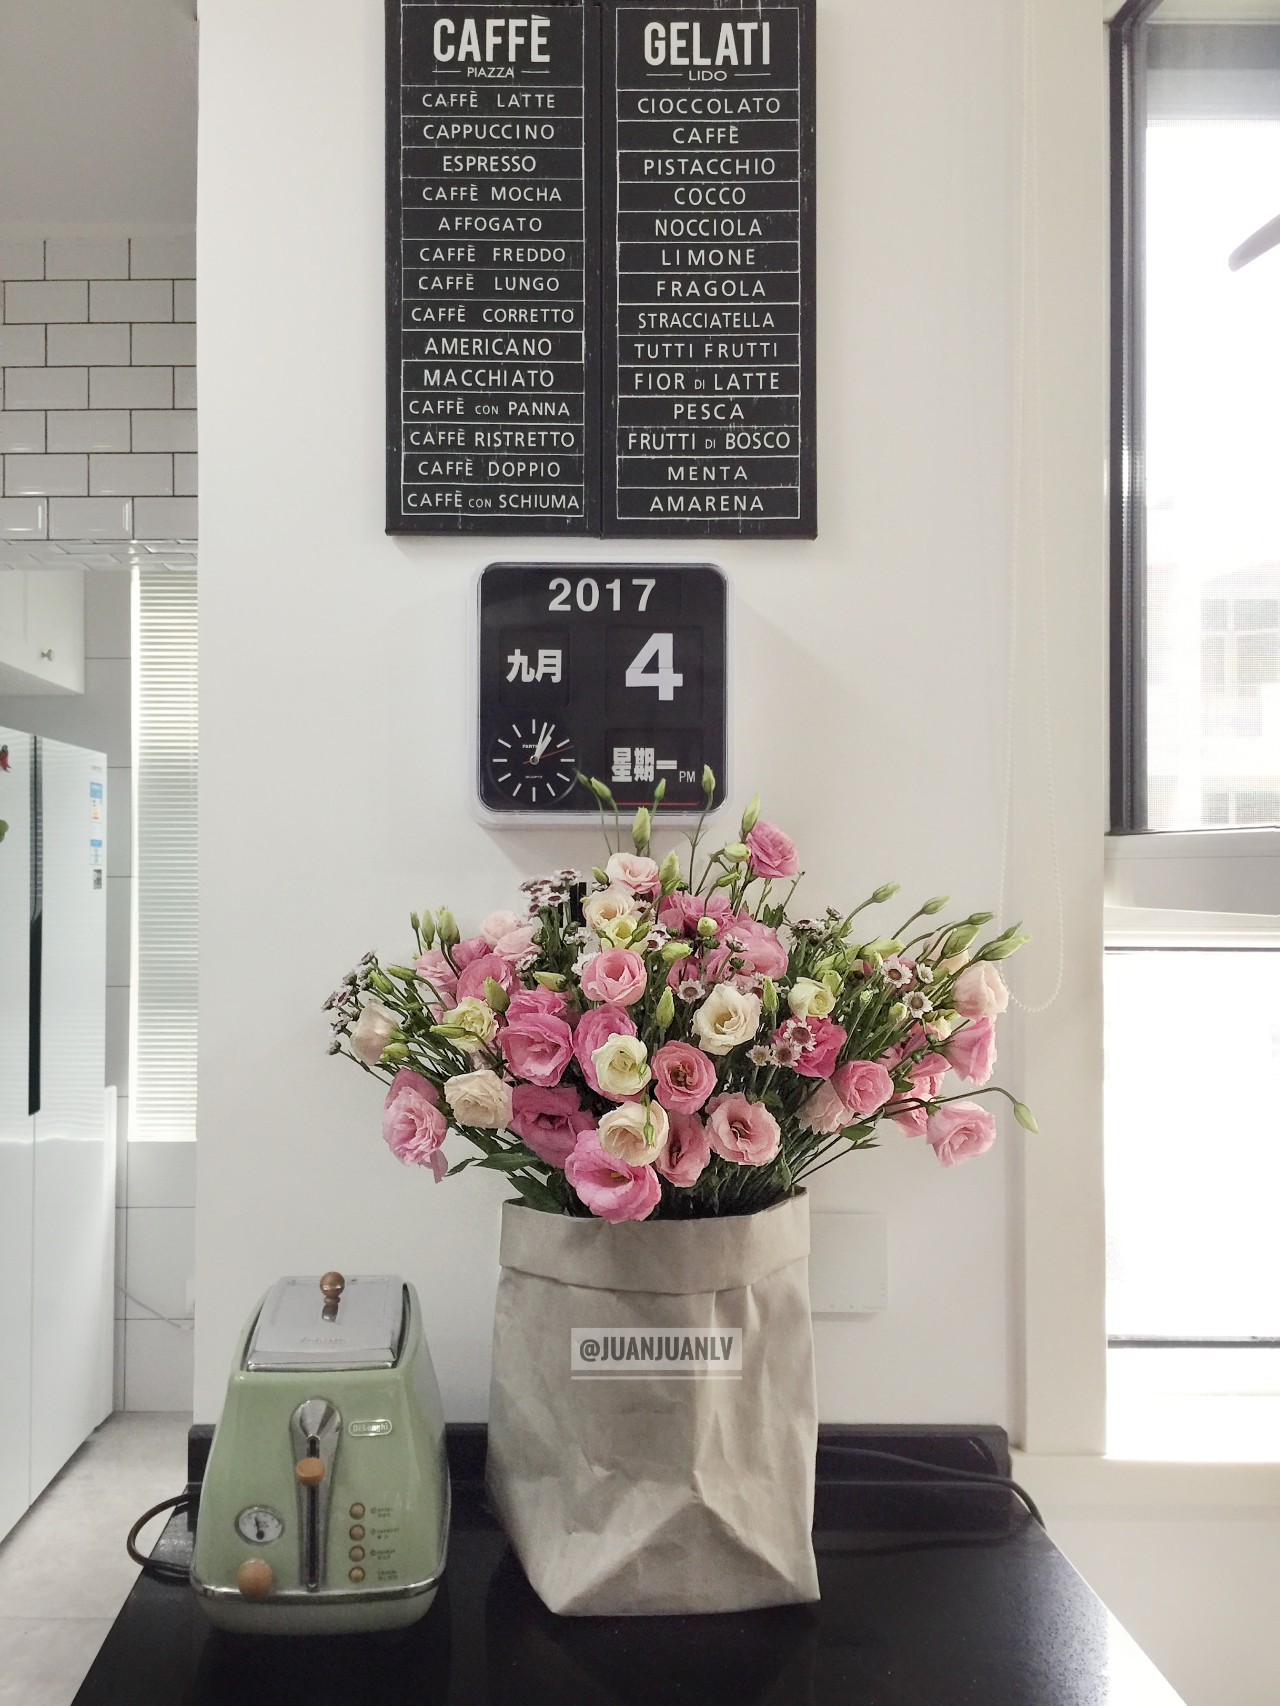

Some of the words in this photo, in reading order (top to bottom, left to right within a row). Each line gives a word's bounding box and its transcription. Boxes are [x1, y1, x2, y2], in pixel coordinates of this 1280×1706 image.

[434, 14, 550, 62] CAFFÈ
[644, 22, 770, 65] GELATI
[468, 67, 514, 78] PIAZZA
[689, 70, 727, 81] LIDO
[422, 91, 477, 107] CAFFÈ
[498, 94, 554, 108] LATTE
[638, 98, 780, 114] CIOCCOLATO
[423, 124, 554, 139] CAPPUCCINO
[673, 126, 738, 144] CAFFÈ
[444, 156, 536, 172] ESPRESSO
[645, 158, 775, 175] PISTACCHIO
[423, 184, 478, 201] CAFFÈ
[492, 187, 561, 201] MOCHA
[675, 187, 745, 205] COCCO
[438, 217, 542, 231] AFFOGATO
[656, 219, 762, 236] NOCCIOLA
[420, 245, 475, 262] CAFFÈ
[494, 248, 565, 262] FREDDO
[662, 249, 755, 265] LIMONE
[419, 273, 474, 290] CAFFÈ
[495, 277, 559, 291] LUNGO
[657, 280, 765, 297] FRAGOLA
[412, 305, 465, 322] CAFFÈ
[483, 309, 573, 323] CORRETTO
[639, 312, 774, 328] STRACCIATELLA
[425, 338, 551, 355] AMERICANO
[634, 344, 692, 358] TUTTI
[705, 343, 776, 358] FRUTTI
[424, 369, 554, 387] MACCHIATO
[635, 373, 685, 390] FIOR
[695, 379, 704, 389] DI
[715, 373, 779, 390] LATTE
[409, 398, 464, 414] CAFFÈ
[475, 405, 498, 414] CON
[509, 402, 569, 416] PANNA
[674, 404, 744, 420] PESCA
[410, 429, 465, 445] CAFFÈ
[475, 432, 574, 447] RISTRETTO
[629, 433, 695, 450] FRUTTI
[705, 439, 715, 449] DI
[726, 432, 790, 449] BOSCO
[419, 459, 473, 476] CAFFÈ
[489, 462, 560, 477] DOPPIO
[668, 466, 747, 480] MENTA
[408, 490, 462, 507] CAFFÈ
[469, 499, 491, 508] CON
[499, 494, 579, 508] SCHIUMA
[650, 496, 763, 511] AMARENA
[548, 577, 656, 612] 2017
[506, 649, 562, 683] 九月
[625, 632, 684, 701] 4
[611, 747, 678, 782] 星期一
[679, 770, 696, 783] PM
